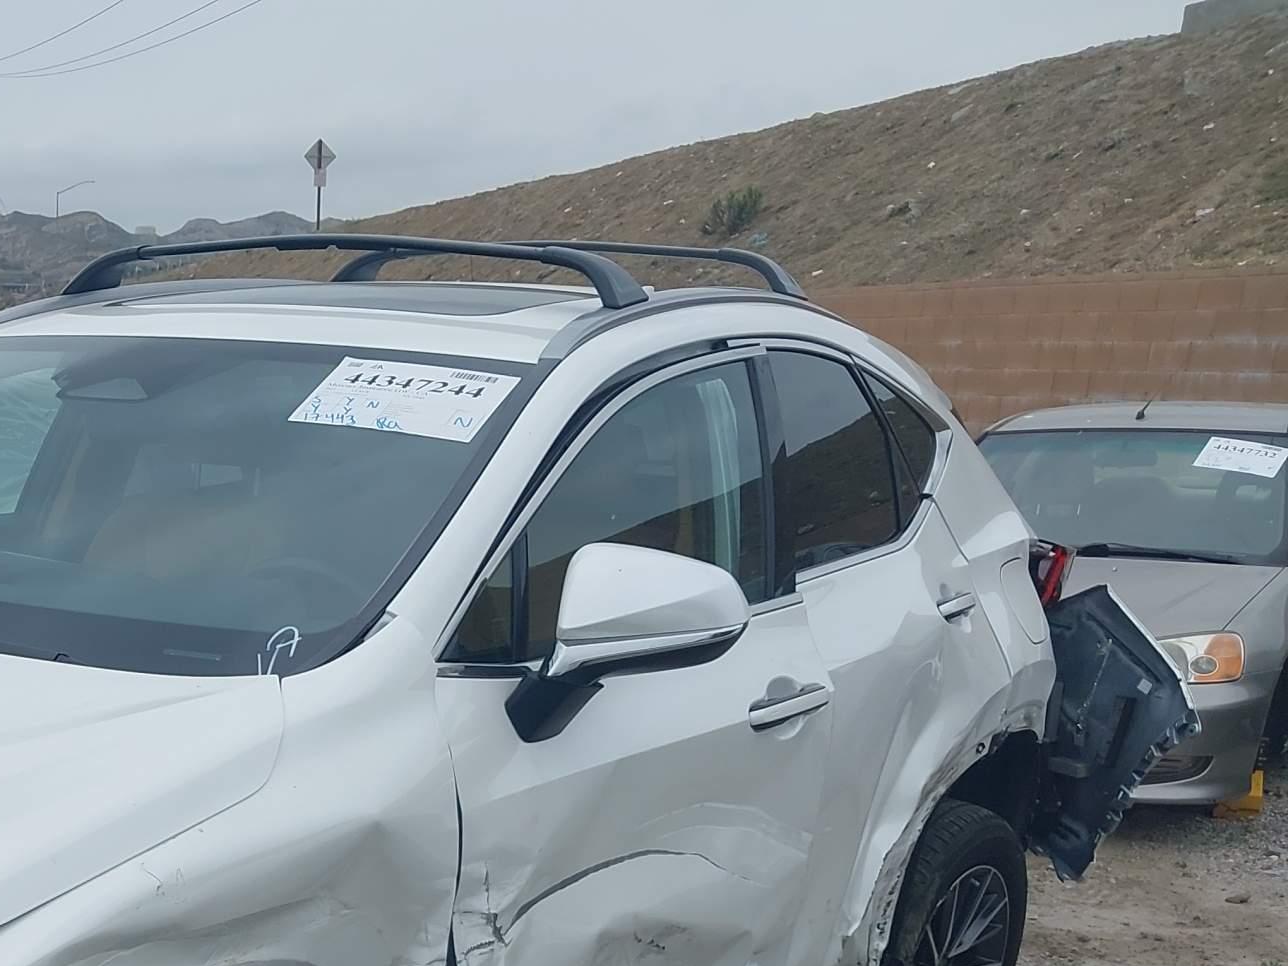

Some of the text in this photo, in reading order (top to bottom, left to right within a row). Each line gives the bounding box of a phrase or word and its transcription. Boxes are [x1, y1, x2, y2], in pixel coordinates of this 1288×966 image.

[344, 373, 485, 398] 44347244
[367, 400, 380, 409] N
[454, 417, 473, 428] N
[1213, 444, 1277, 458] 44347732
